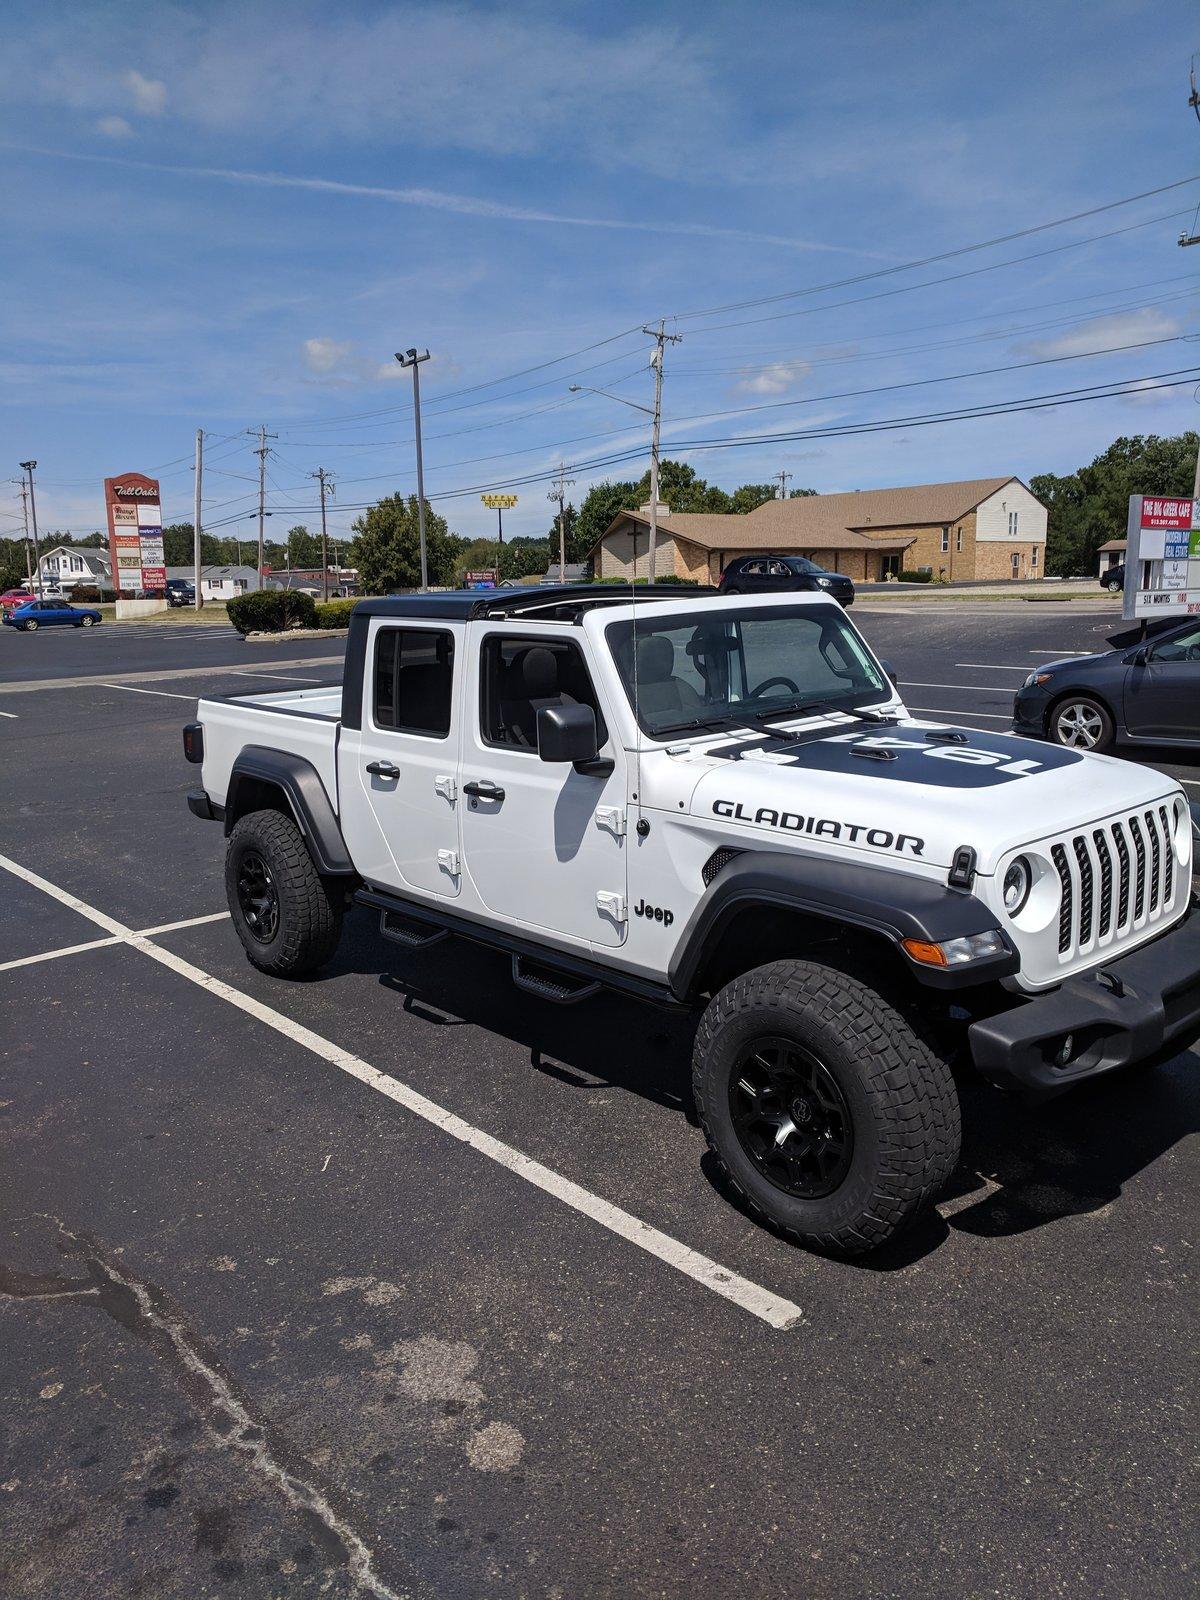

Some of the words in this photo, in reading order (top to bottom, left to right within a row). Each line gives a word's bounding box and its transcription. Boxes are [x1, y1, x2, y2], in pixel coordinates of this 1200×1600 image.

[114, 485, 134, 496] Tall
[134, 486, 158, 496] Oaks
[1143, 500, 1153, 516] THE
[1163, 502, 1178, 517] GREEK
[1179, 503, 1191, 518] CAFE
[1165, 545, 1175, 558] REAL
[1175, 545, 1188, 558] ESTATE
[1143, 594, 1152, 605] SIX
[1153, 594, 1171, 604] MONTHS
[712, 799, 925, 857] GLADIATOR
[634, 898, 674, 928] Jeep
